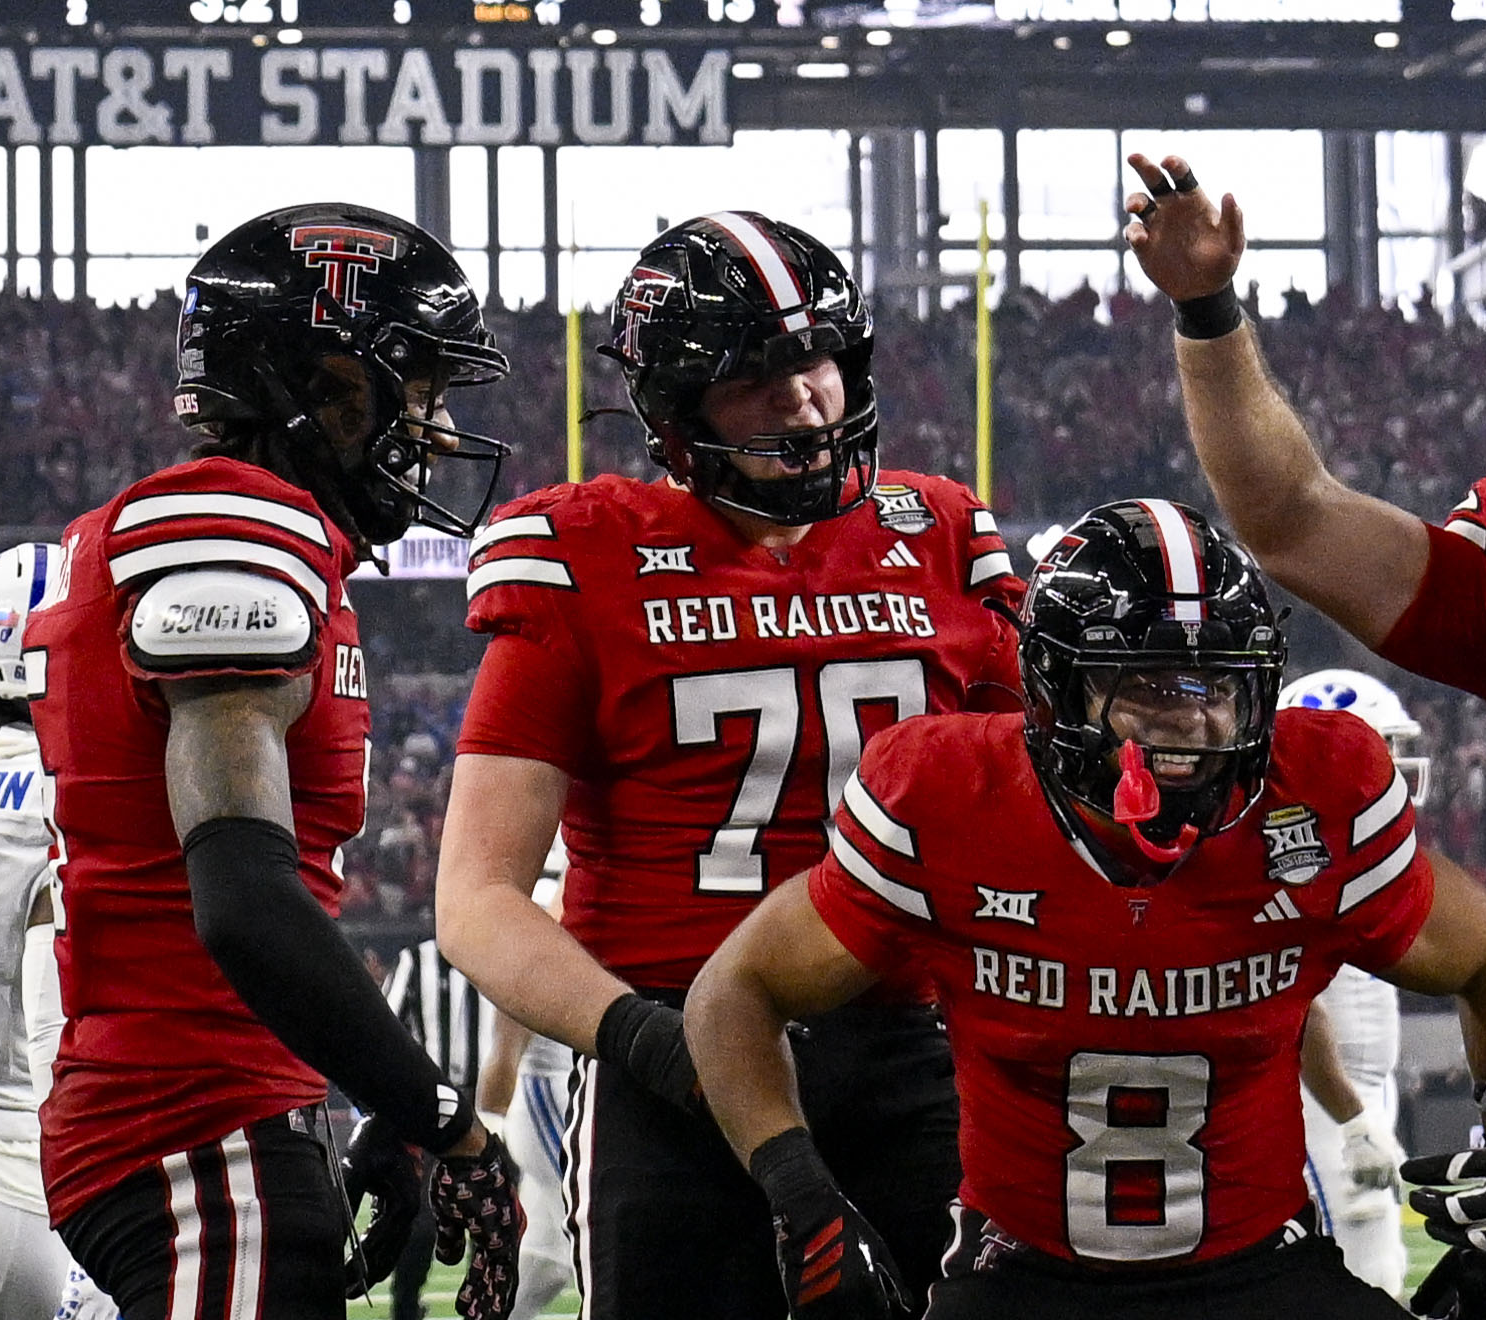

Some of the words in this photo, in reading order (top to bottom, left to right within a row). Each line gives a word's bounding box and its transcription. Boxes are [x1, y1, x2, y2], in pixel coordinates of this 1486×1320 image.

[260, 47, 733, 144] STADIUM
[873, 491, 927, 516] XII
[636, 545, 696, 574] XII
[643, 596, 737, 644] RED
[751, 592, 936, 638] RAIDERS
[1262, 817, 1323, 859] XII
[975, 886, 1038, 926] XII
[973, 946, 1066, 1009] RED
[1089, 945, 1303, 1017] RAIDERS
[1066, 1052, 1211, 1262] 8
